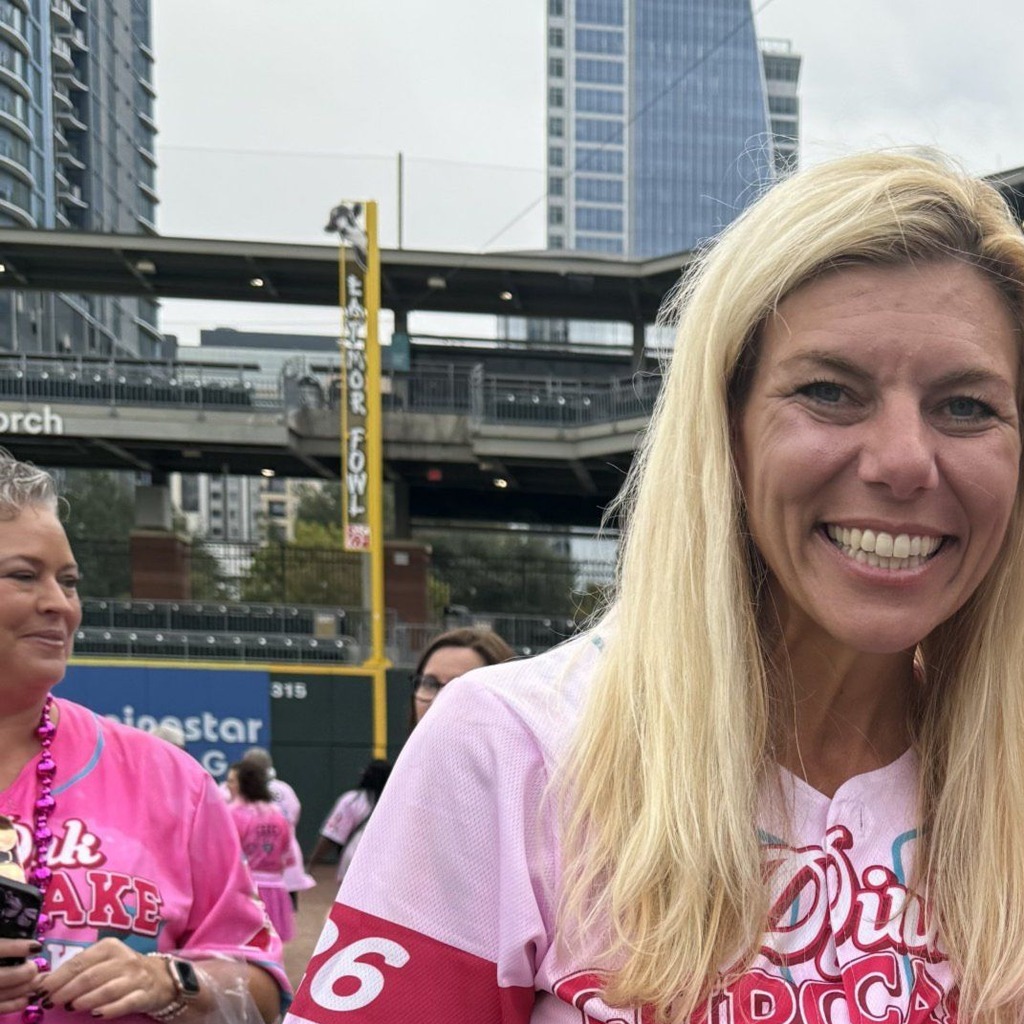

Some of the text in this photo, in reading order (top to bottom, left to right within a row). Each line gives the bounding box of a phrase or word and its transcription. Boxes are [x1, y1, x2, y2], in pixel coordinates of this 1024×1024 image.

[348, 426, 368, 518] FOWL
[270, 682, 307, 699] 315
[43, 870, 164, 938] AKE
